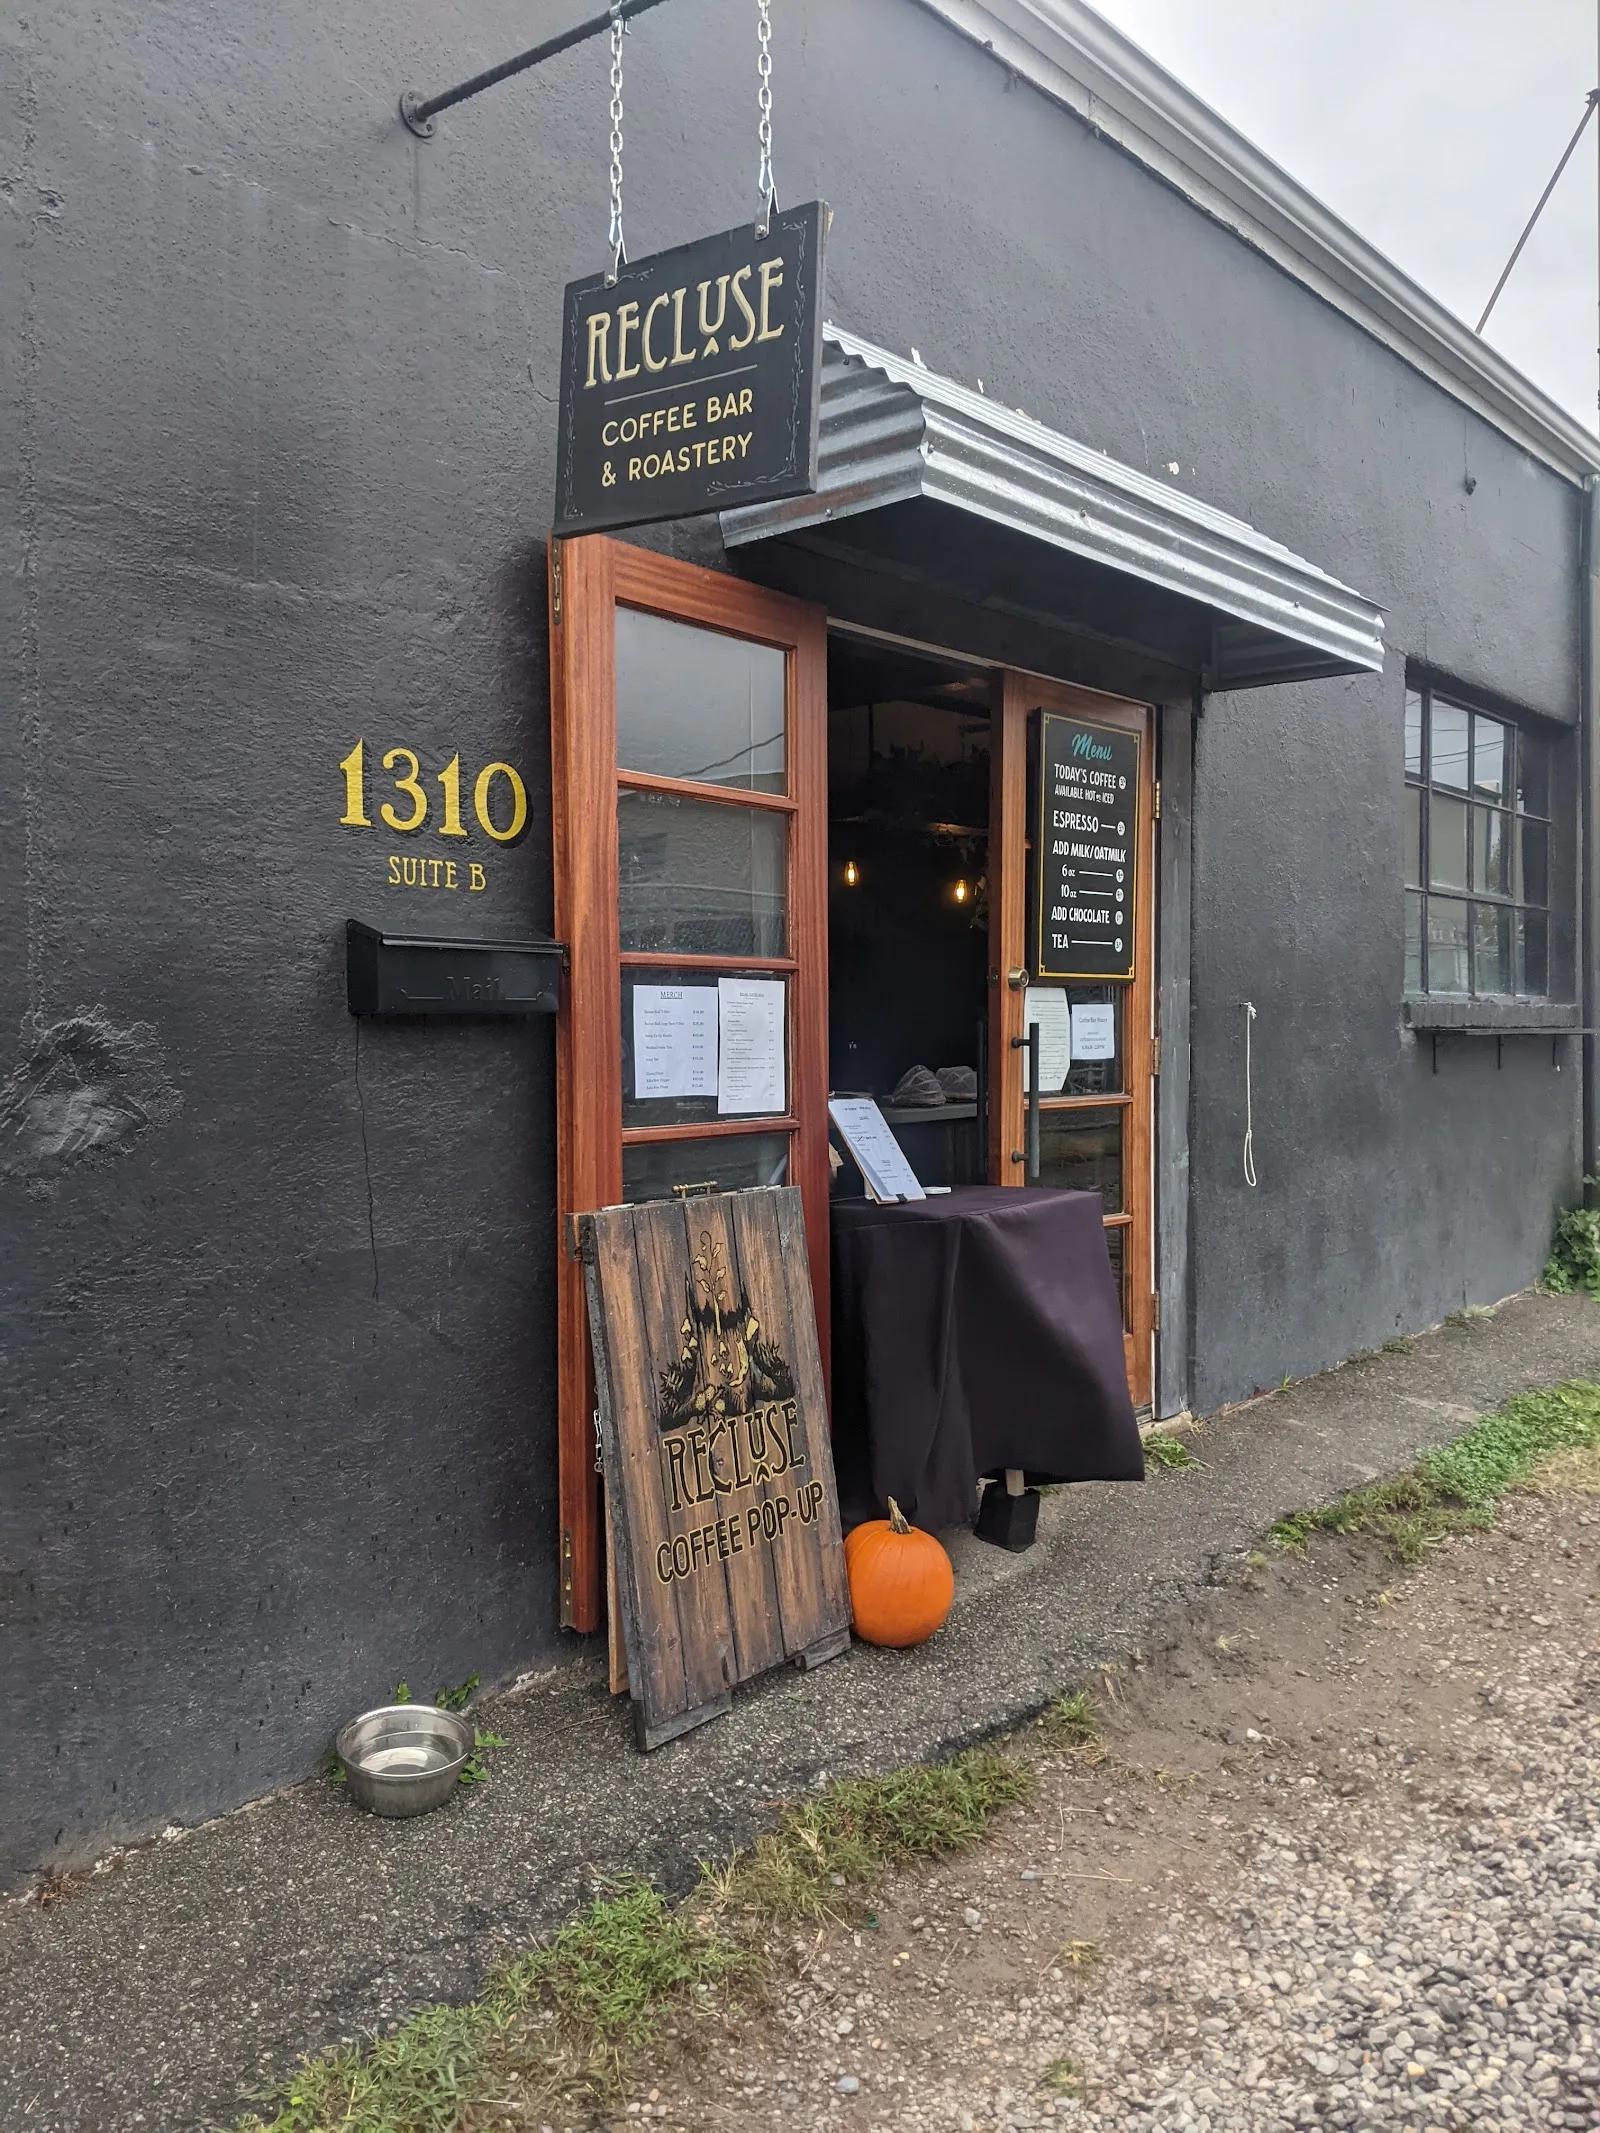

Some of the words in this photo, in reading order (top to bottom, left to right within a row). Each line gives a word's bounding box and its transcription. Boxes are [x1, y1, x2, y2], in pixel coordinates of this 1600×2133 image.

[584, 257, 785, 389] RECLUSE
[601, 402, 698, 447] COFFEE
[706, 388, 754, 424] BAR
[601, 461, 617, 488] &
[628, 432, 754, 482] ROASTERY
[1071, 733, 1113, 761] Menu
[339, 737, 528, 841] 1310
[1054, 763, 1088, 784] TODAY'S
[1089, 770, 1117, 790] COFFEE
[1054, 784, 1085, 800] AVAILABLE
[1085, 789, 1097, 802] HOT
[1102, 792, 1115, 805] ICED
[1053, 810, 1099, 834] ESPRESSO
[1052, 840, 1070, 856] ADD
[388, 856, 460, 890] SUITE
[469, 863, 487, 891] B
[1051, 906, 1068, 921] ADD
[1069, 907, 1111, 925] CHOCOLATE
[1052, 933, 1069, 949] TEA
[660, 991, 683, 999] MERCH
[663, 1399, 806, 1514] RECLUSE
[655, 1513, 744, 1585] COFFEE
[746, 1479, 824, 1547] POP-UP
